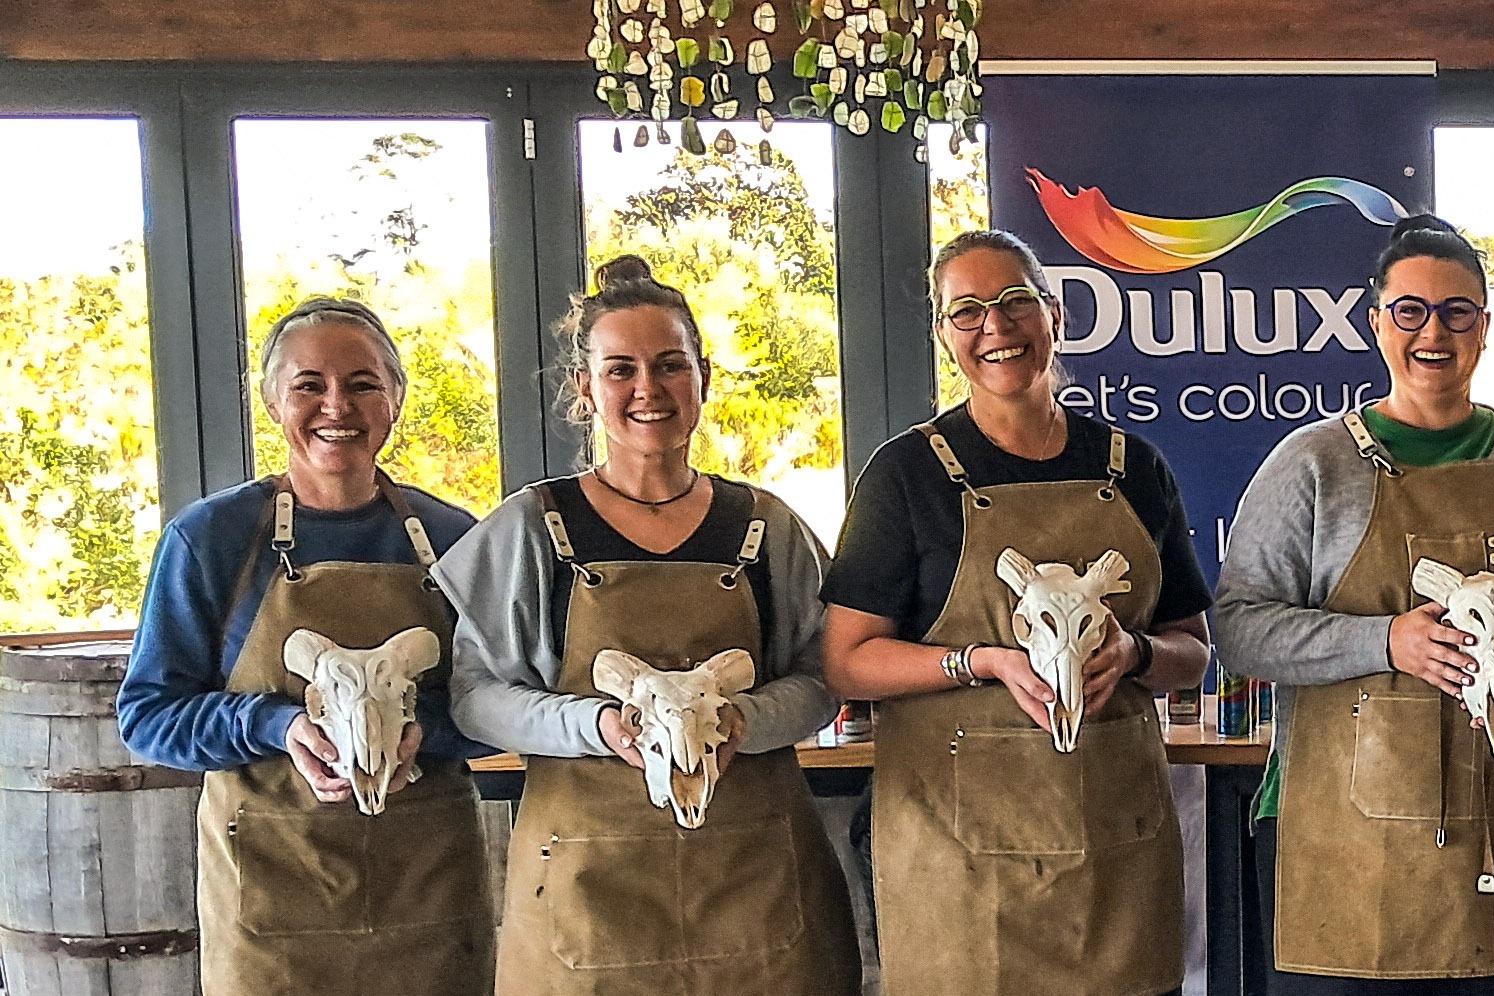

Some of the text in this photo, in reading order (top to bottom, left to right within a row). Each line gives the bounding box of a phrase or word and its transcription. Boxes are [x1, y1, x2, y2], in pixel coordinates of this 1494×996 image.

[1044, 265, 1370, 356] Dulux
[1057, 373, 1373, 422] et's colour
